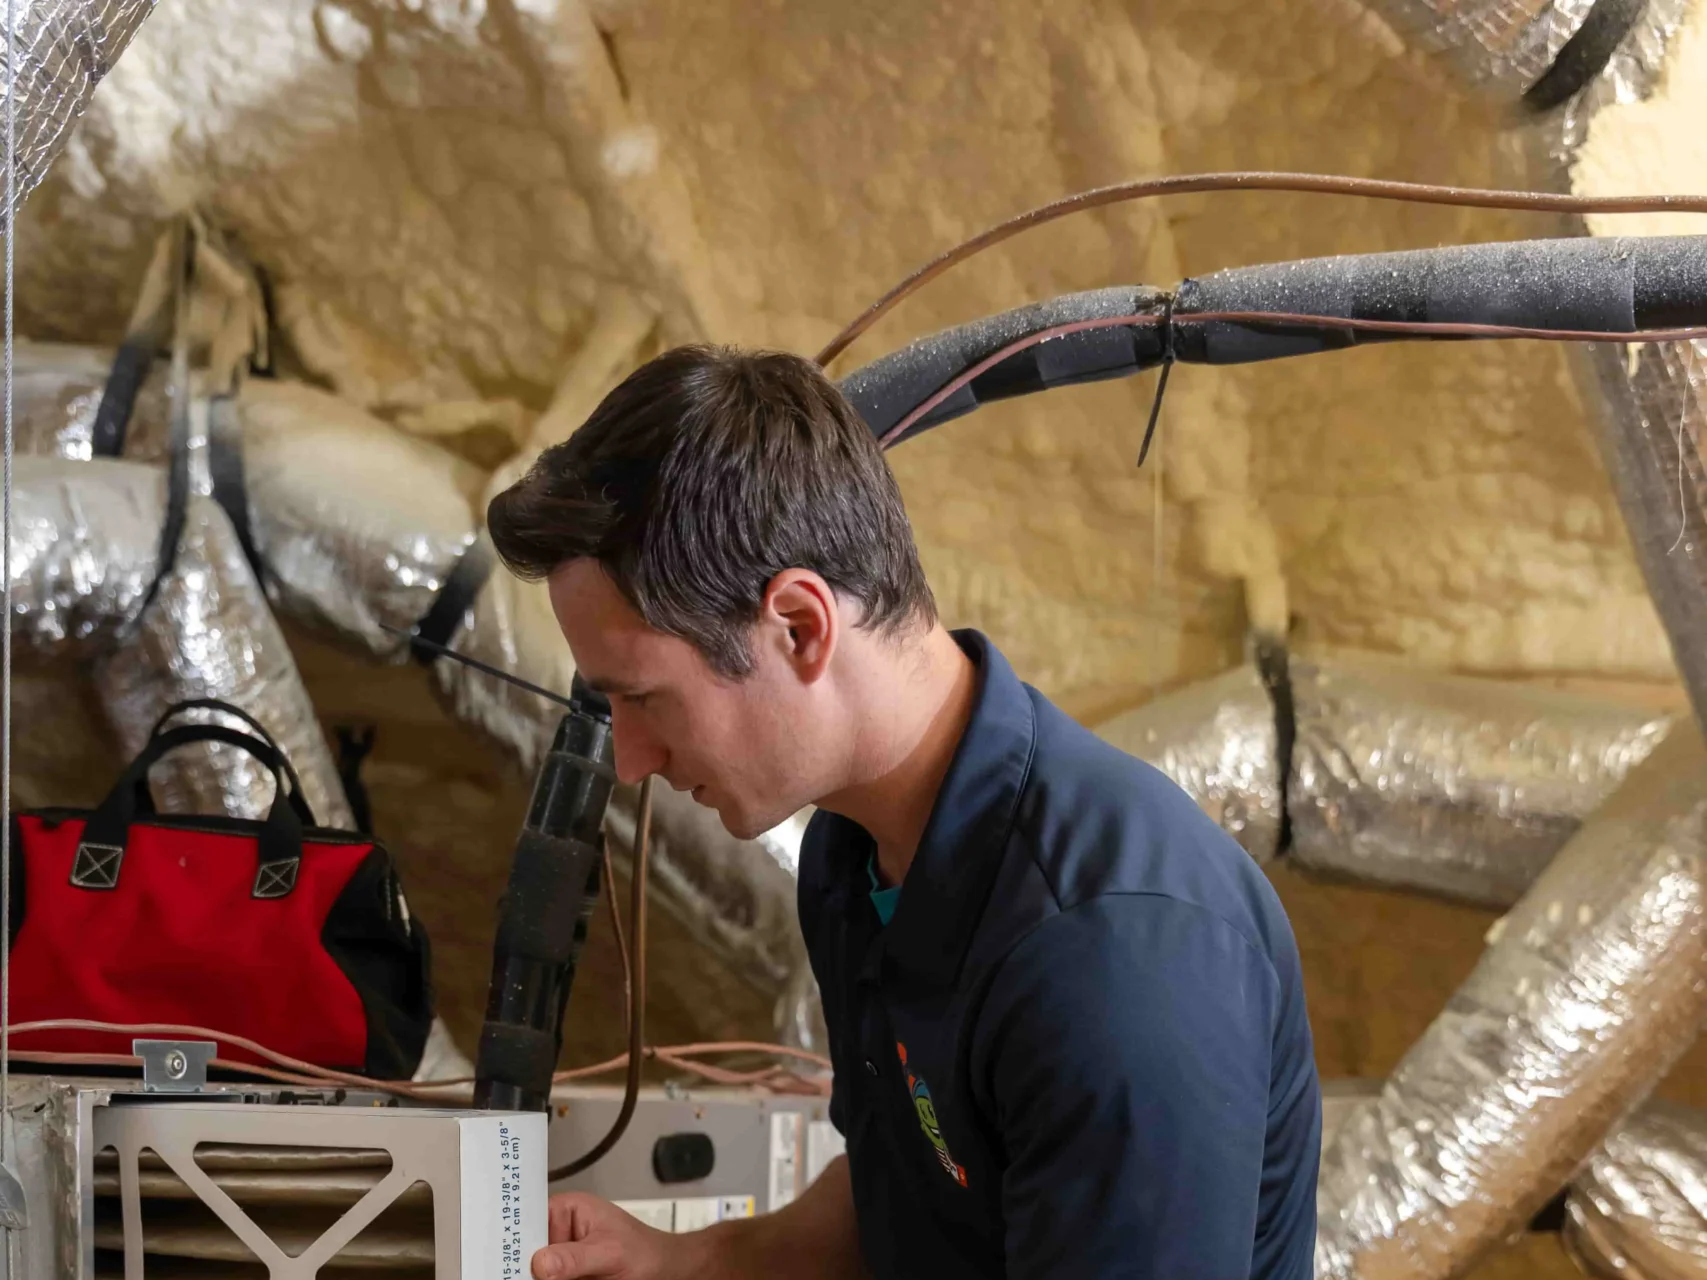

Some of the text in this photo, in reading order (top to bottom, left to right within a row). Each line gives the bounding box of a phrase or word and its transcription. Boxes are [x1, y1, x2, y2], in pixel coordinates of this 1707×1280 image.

[499, 1121, 510, 1160] 3-5/8"
[510, 1137, 521, 1160] cm)
[511, 1166, 520, 1191] 9.21
[502, 1176, 511, 1221] 19-3/8"
[513, 1207, 521, 1225] cm
[502, 1238, 512, 1280] 15-3/8"
[512, 1231, 521, 1263] 49.21
